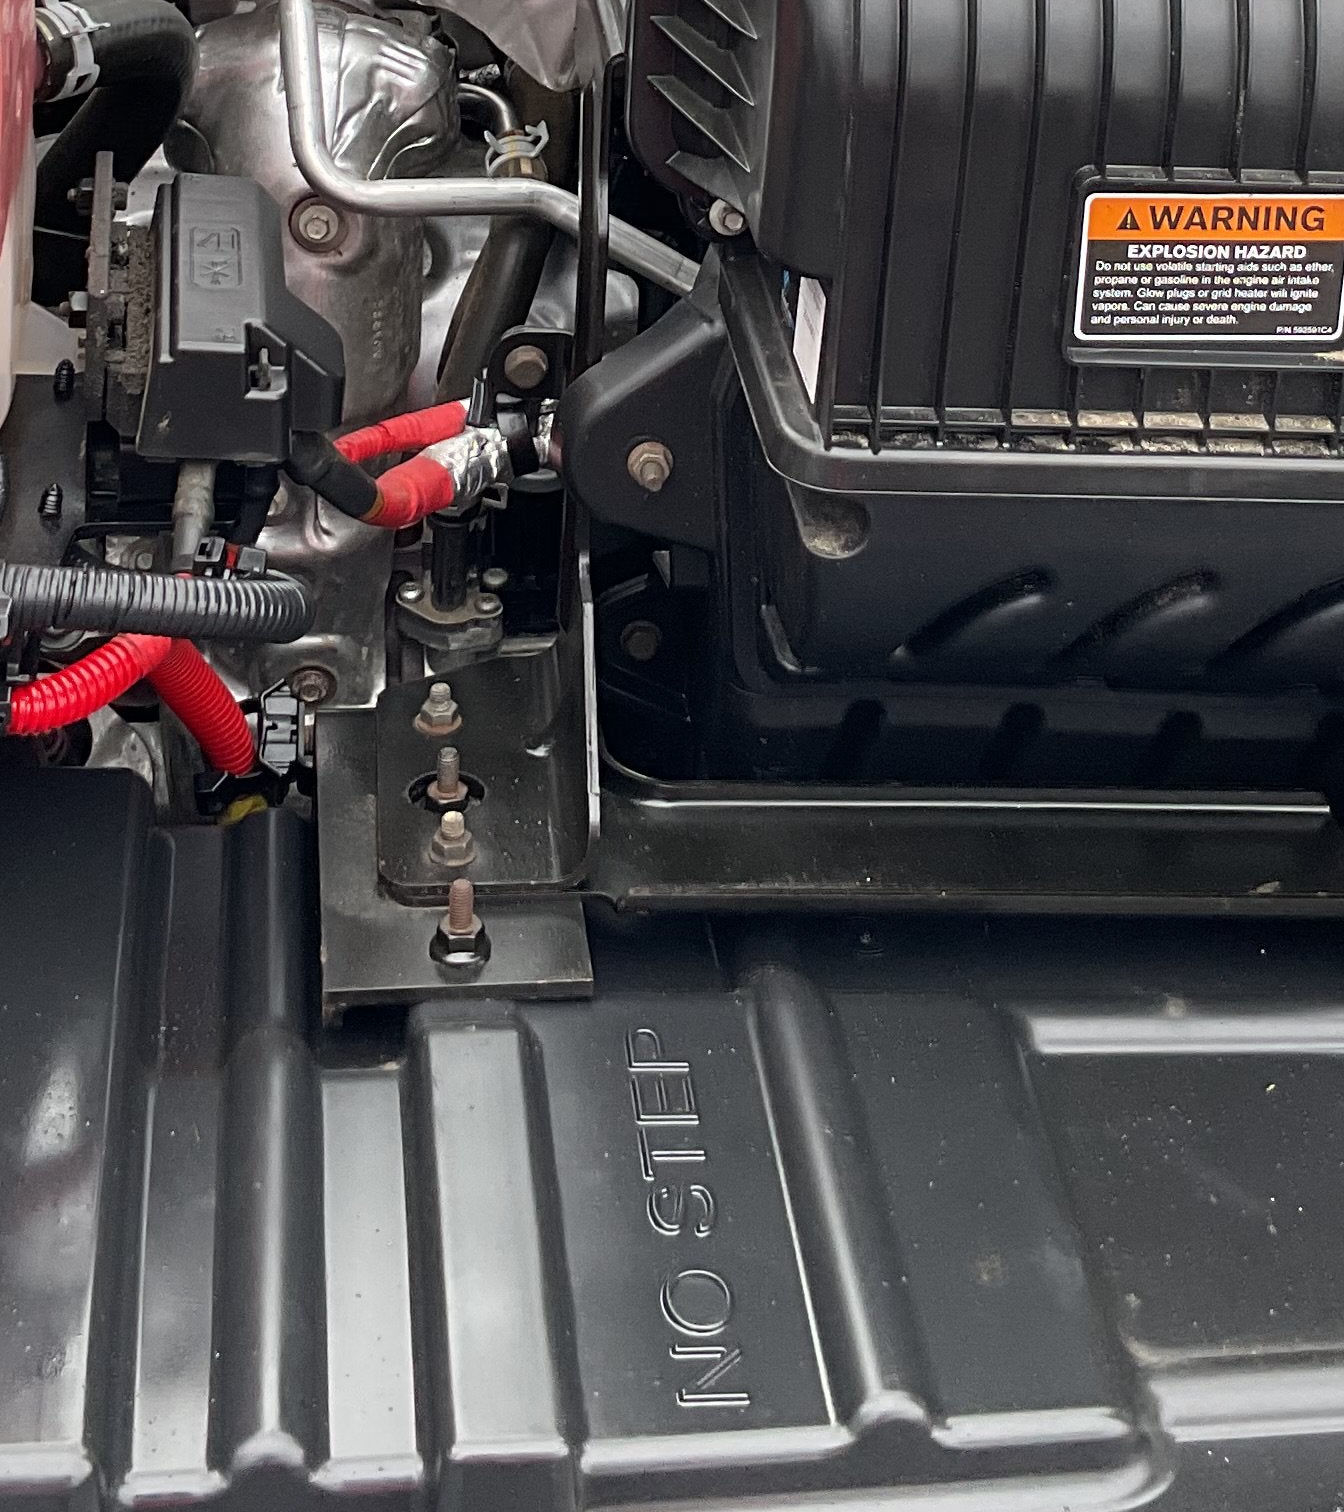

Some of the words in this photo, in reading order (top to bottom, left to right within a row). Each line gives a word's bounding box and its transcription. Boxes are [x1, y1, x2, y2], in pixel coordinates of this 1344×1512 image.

[1149, 205, 1325, 232] WARNING
[1127, 244, 1230, 259] EXPLOSION
[1234, 245, 1307, 259] HAZARD
[1095, 260, 1112, 271] Do
[1113, 262, 1131, 271] not
[1133, 263, 1153, 271] use
[1156, 262, 1193, 271] volatile
[1195, 262, 1235, 274] starting
[1236, 262, 1260, 272] aids
[1261, 262, 1287, 272] such
[1289, 263, 1303, 272] as
[1305, 262, 1335, 273] ether,
[1093, 275, 1138, 287] propane
[1140, 276, 1152, 284] or
[1154, 275, 1199, 286] gasoline
[1201, 275, 1212, 284] in
[1213, 276, 1231, 285] the
[1232, 275, 1269, 286] engine
[1270, 275, 1286, 285] air
[1287, 275, 1320, 285] intake
[1092, 288, 1134, 299] system.
[1136, 288, 1164, 298] Glow
[1166, 288, 1196, 299] plugs
[1197, 289, 1210, 298] or
[1211, 288, 1232, 299] grid
[1234, 288, 1268, 298] heater
[1270, 289, 1288, 298] will
[1289, 289, 1319, 300] ignite
[1091, 302, 1130, 312] vapors.
[1133, 300, 1156, 311] Can
[1158, 302, 1191, 311] cause
[1192, 302, 1229, 311] severe
[1230, 301, 1267, 313] engine
[1268, 301, 1313, 313] damage
[1090, 314, 1111, 324] and
[1113, 314, 1160, 326] personal
[1161, 314, 1191, 326] injury
[1192, 316, 1204, 324] or
[1205, 314, 1239, 324] death.
[624, 1028, 716, 1238] STEP
[660, 1269, 750, 1407] NO
